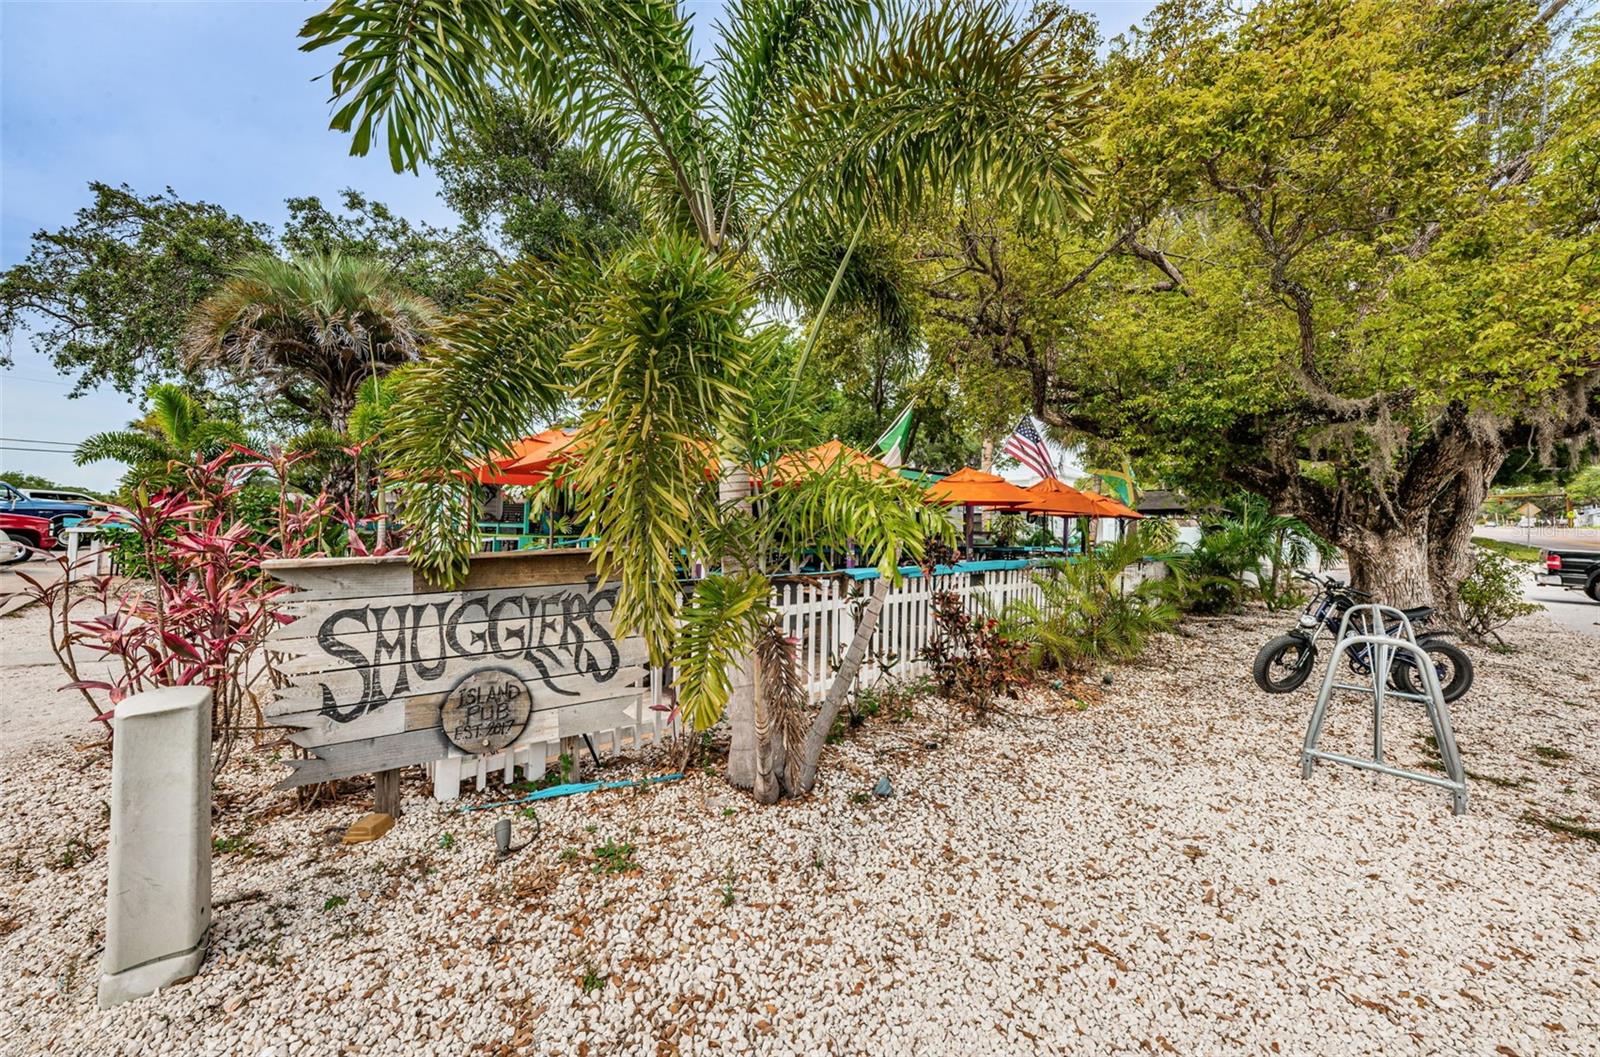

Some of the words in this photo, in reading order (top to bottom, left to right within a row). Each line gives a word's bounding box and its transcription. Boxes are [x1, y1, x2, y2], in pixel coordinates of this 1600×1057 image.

[457, 682, 521, 709] ISLAND
[466, 702, 510, 725] PUB
[485, 720, 516, 737] 2017
